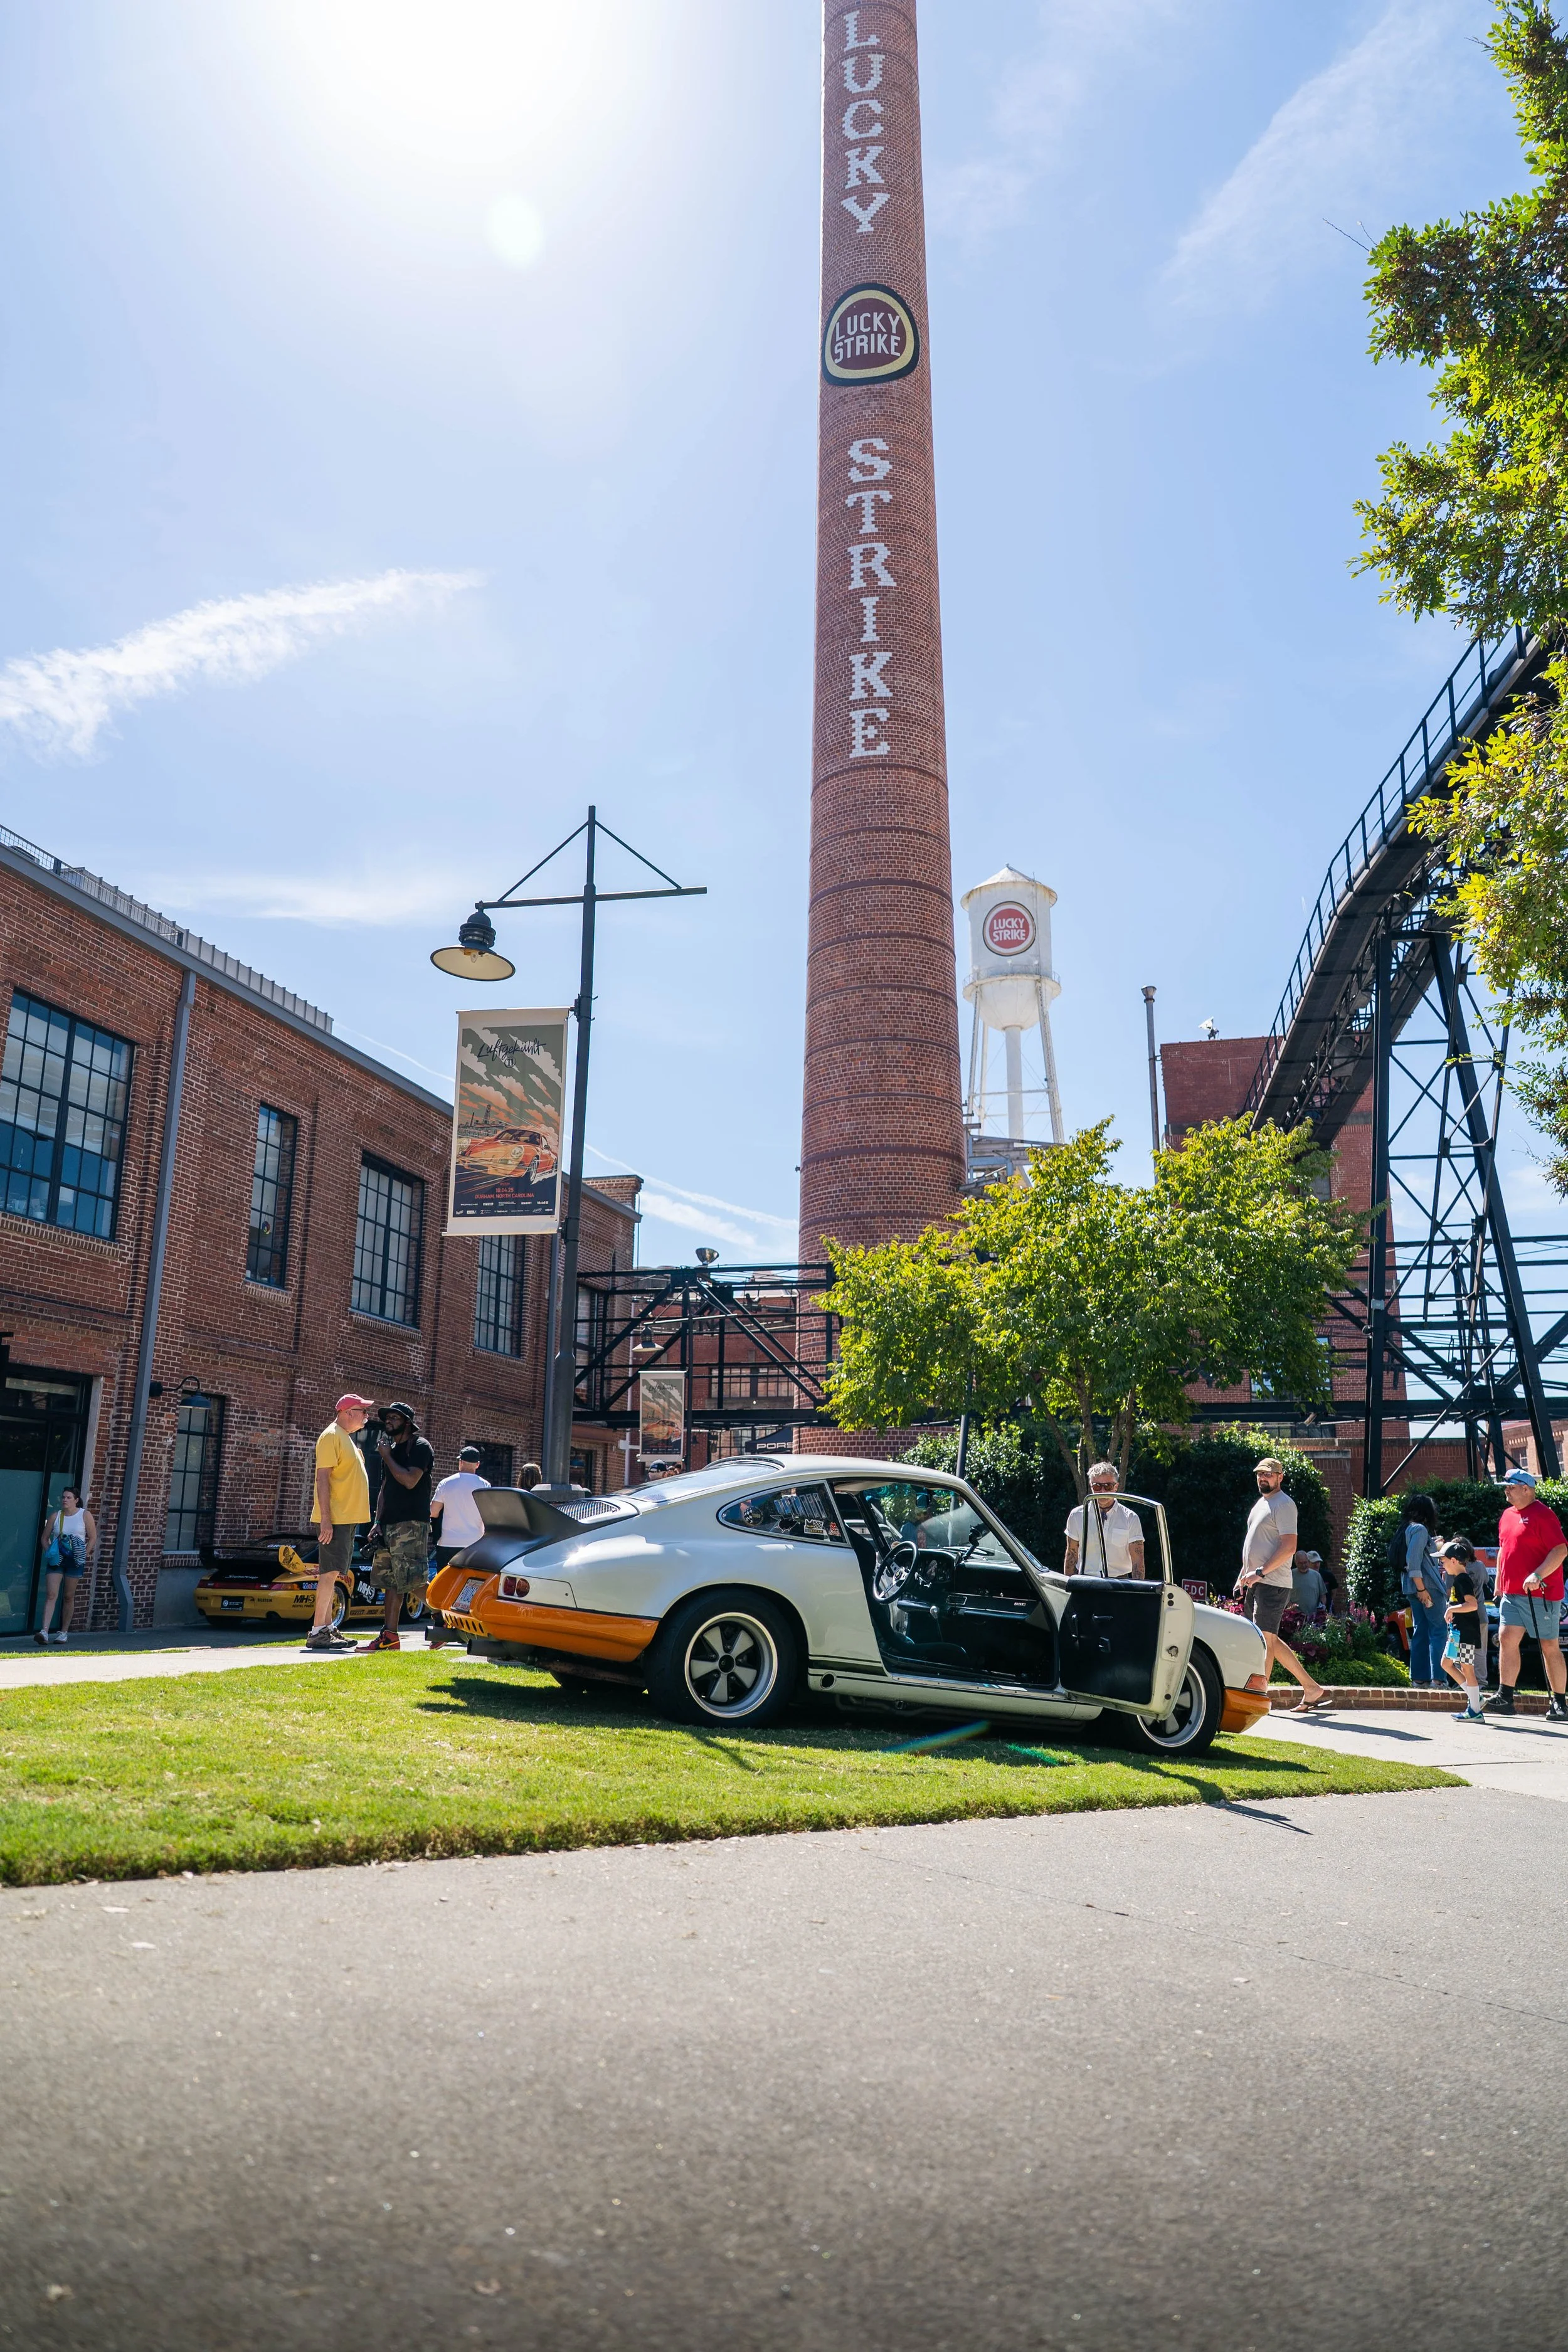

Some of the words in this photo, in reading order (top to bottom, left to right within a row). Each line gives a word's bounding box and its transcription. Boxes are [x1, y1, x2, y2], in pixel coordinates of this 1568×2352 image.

[841, 9, 890, 233] LUCKY
[835, 311, 901, 342] LUCKY
[834, 333, 901, 365] STRIKE
[845, 437, 897, 759] STRIKE
[993, 918, 1025, 930] LUCKY
[993, 929, 1026, 942] STRIKE
[477, 1038, 546, 1061] Luftgekühlt
[294, 1594, 315, 1603] MHS
[357, 1581, 376, 1600] MHS
